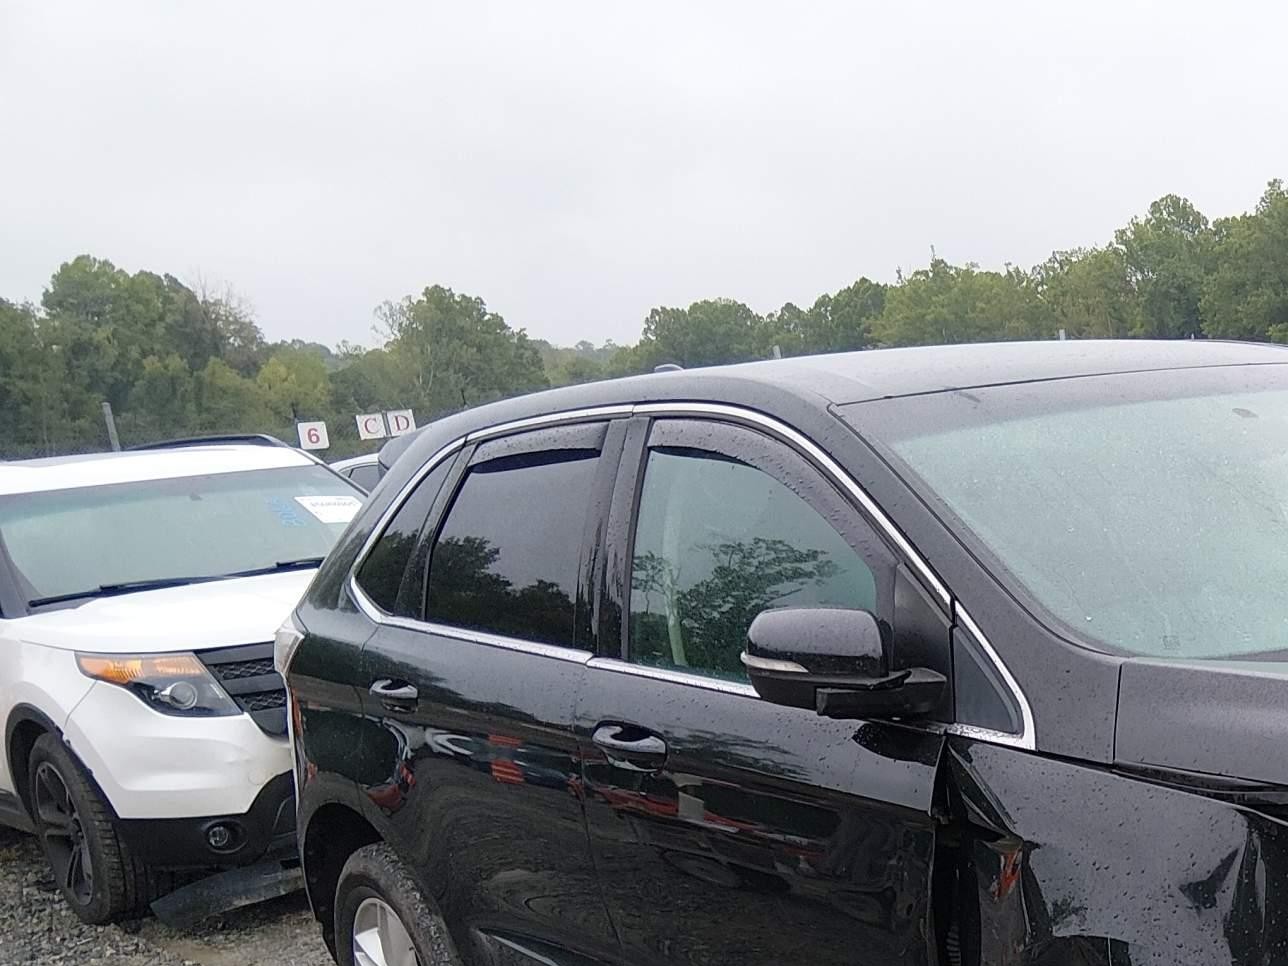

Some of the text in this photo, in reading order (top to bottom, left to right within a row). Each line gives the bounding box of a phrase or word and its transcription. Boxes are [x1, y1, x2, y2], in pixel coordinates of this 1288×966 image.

[364, 417, 379, 435] C
[394, 415, 411, 432] D
[307, 427, 320, 444] 6
